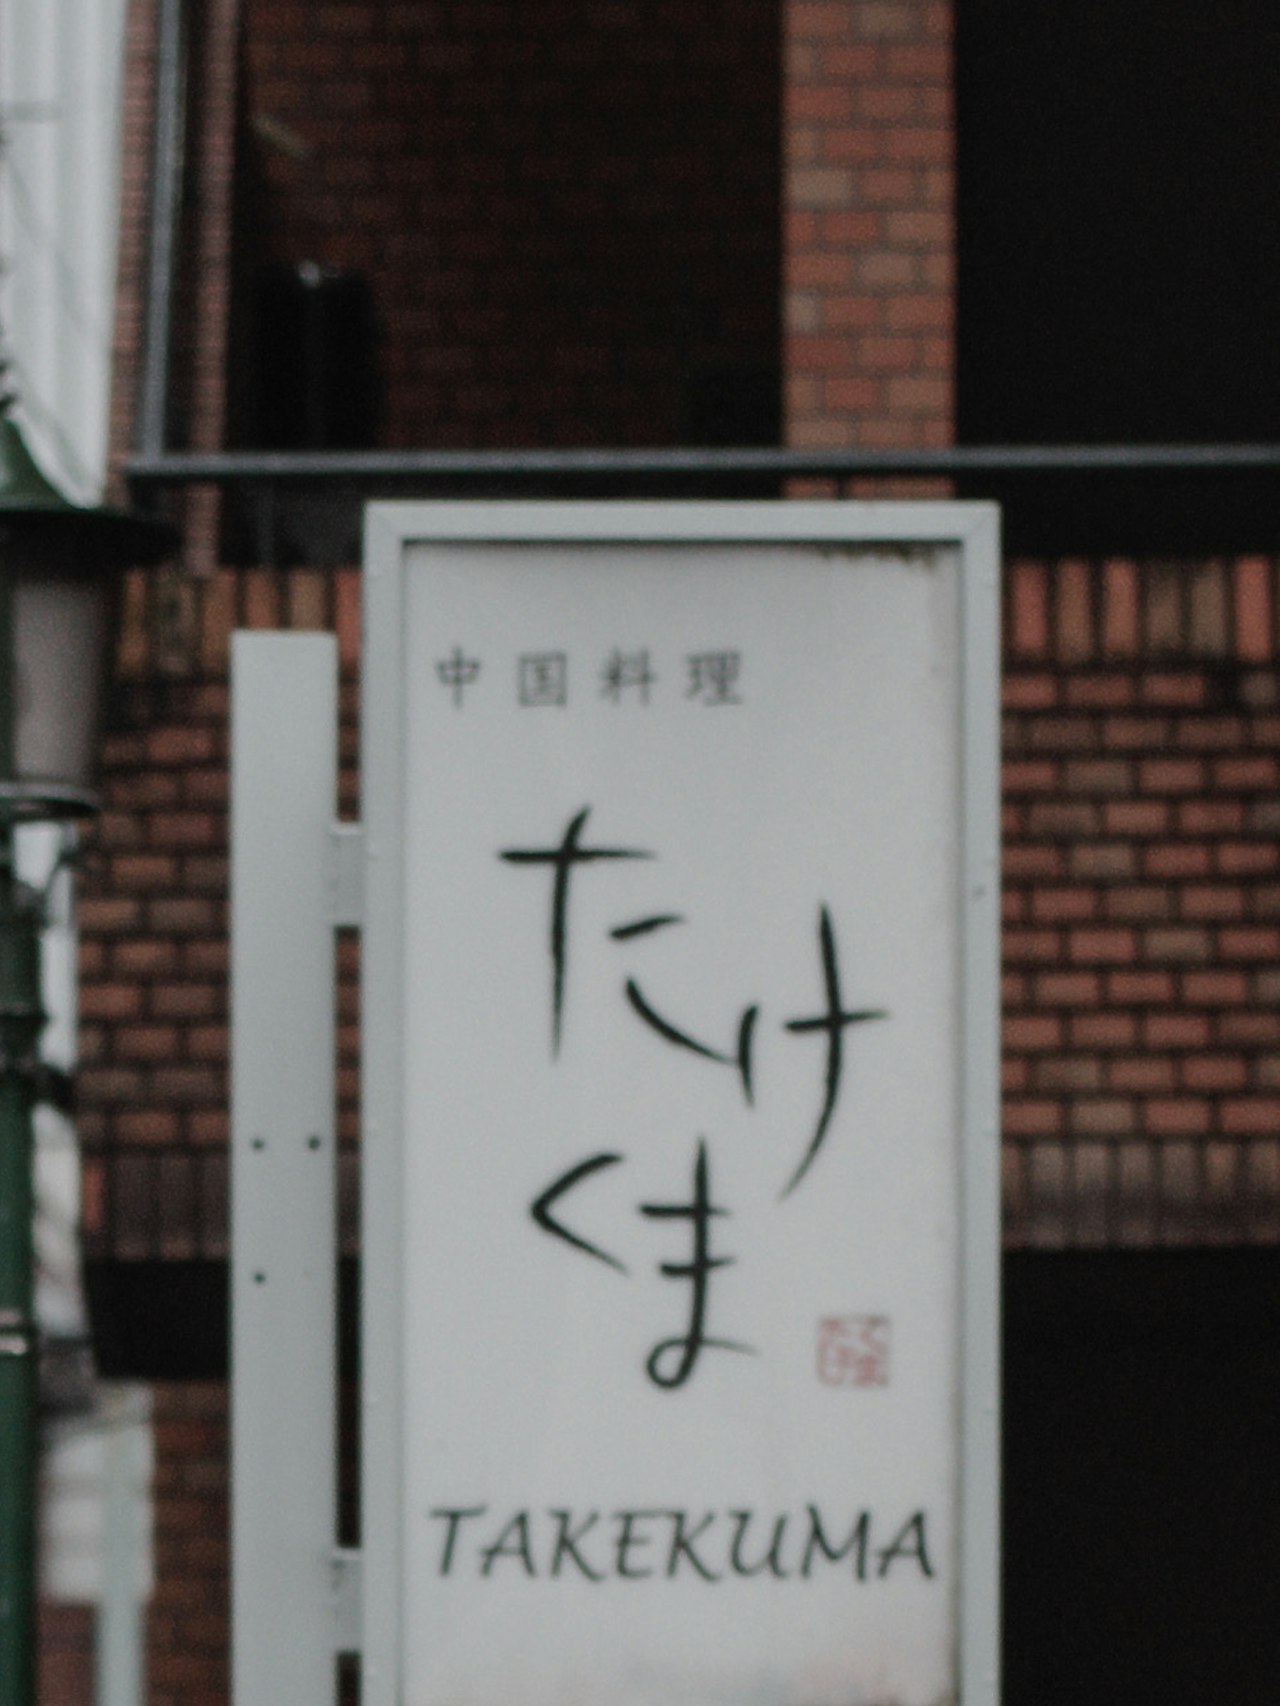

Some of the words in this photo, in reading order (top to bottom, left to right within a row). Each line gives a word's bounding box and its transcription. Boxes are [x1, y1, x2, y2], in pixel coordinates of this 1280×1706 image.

[435, 646, 744, 708] 中国料理
[496, 803, 892, 1202] たけ
[532, 1132, 760, 1390] くま
[430, 1504, 937, 1583] TAKEKUMA
